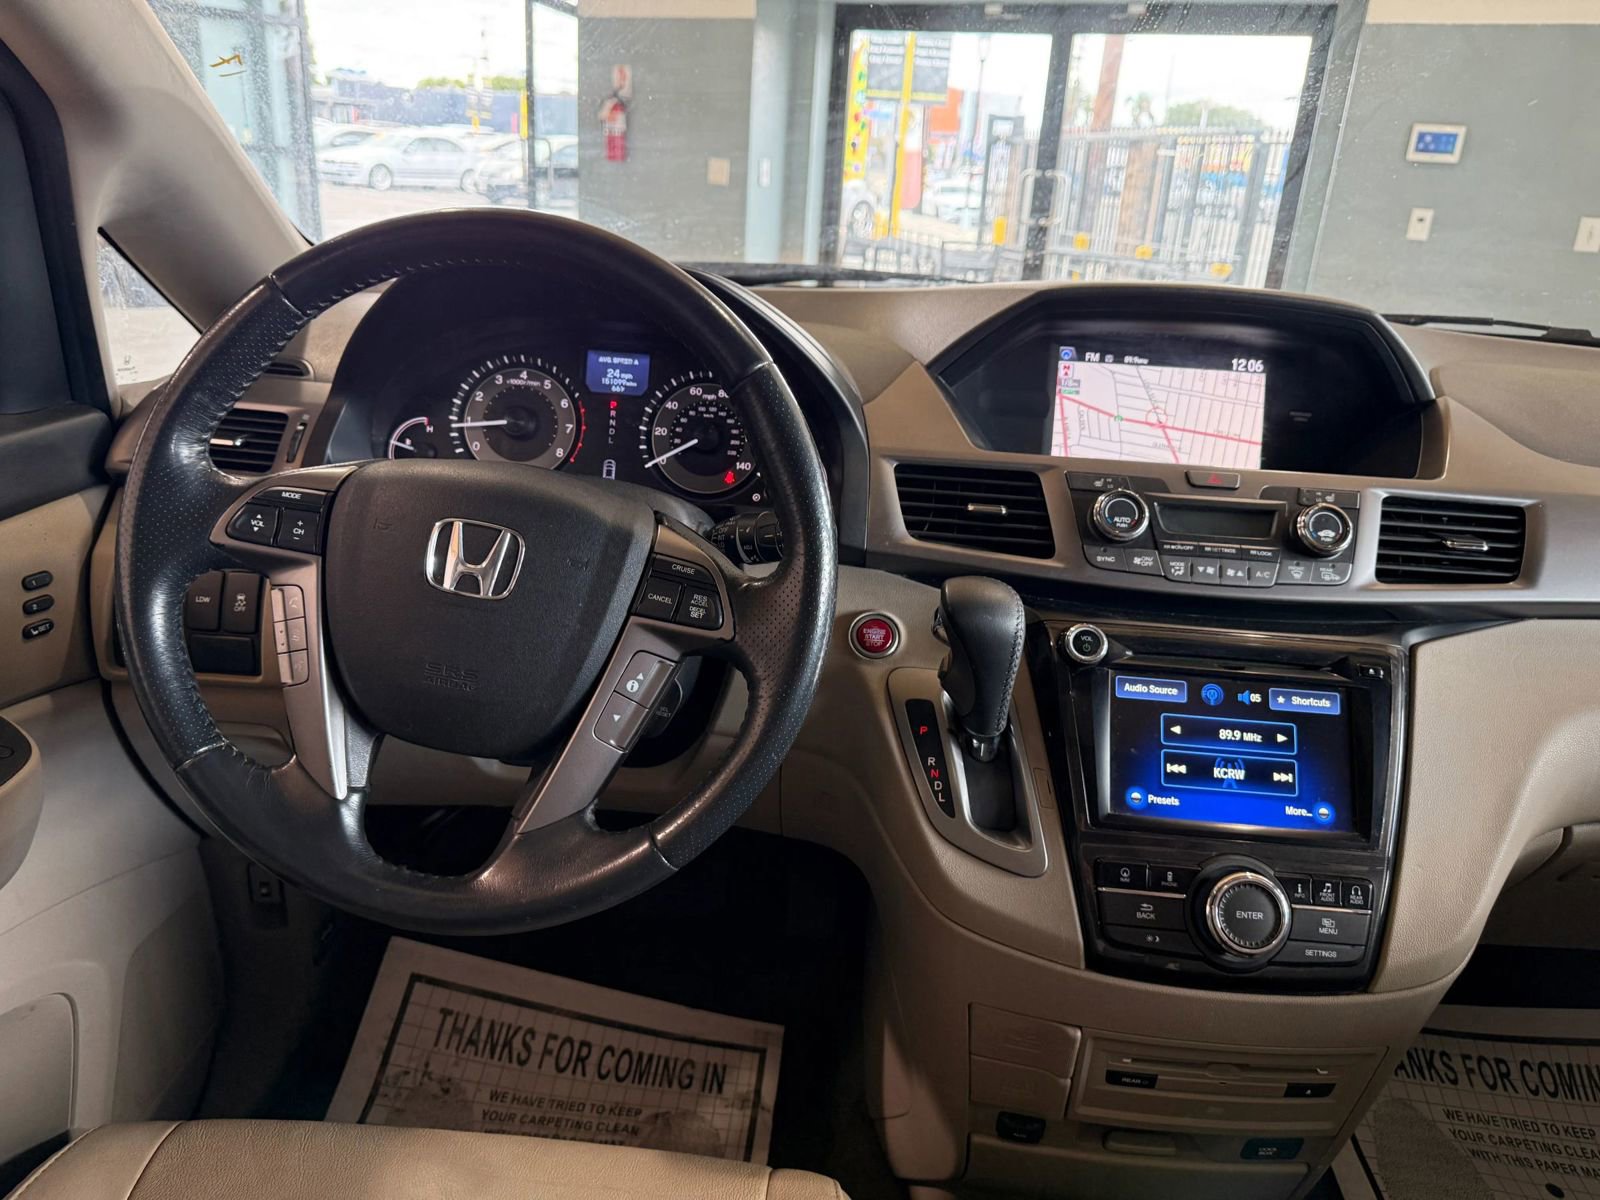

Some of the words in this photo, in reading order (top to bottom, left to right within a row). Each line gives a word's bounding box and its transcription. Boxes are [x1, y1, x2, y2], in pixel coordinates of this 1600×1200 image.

[1085, 352, 1100, 362] FM
[520, 370, 528, 380] 4
[607, 368, 620, 378] 24
[495, 375, 503, 385] 3
[543, 380, 552, 390] 5
[475, 391, 484, 402] 2
[689, 387, 703, 396] 60
[560, 399, 569, 408] 6
[665, 401, 678, 410] 40
[609, 419, 616, 427] N
[426, 425, 434, 433] H
[565, 424, 573, 434] 7
[654, 427, 668, 436] 20
[472, 442, 480, 451] 0
[556, 448, 564, 458] 8
[736, 462, 751, 470] 140
[281, 491, 302, 499] MODE
[251, 519, 264, 527] VOL
[293, 527, 304, 535] CH
[672, 563, 695, 575] CRUISE
[648, 593, 673, 605] CANCEL
[690, 611, 704, 619] SET
[1124, 682, 1148, 694] Audio
[1150, 685, 1178, 696] Source
[1250, 693, 1262, 703] 05
[1291, 696, 1331, 708] Shortcuts
[1218, 729, 1241, 741] 89.9
[1243, 733, 1262, 743] MHz
[928, 757, 936, 766] R
[931, 769, 939, 778] N
[1213, 767, 1245, 780] KCRW
[935, 781, 943, 790] D
[939, 793, 945, 802] L
[1148, 795, 1180, 807] Presets
[1136, 912, 1156, 920] BACK
[1236, 910, 1264, 920] ENTER
[1318, 927, 1338, 935] MENU
[1305, 949, 1337, 958] SETTINGS
[432, 1007, 536, 1067] THANKS
[537, 1035, 591, 1077] FOR
[598, 1044, 696, 1091] COMING
[702, 1063, 727, 1095] IN
[1460, 1054, 1519, 1094] FOR
[489, 1089, 509, 1103] WE
[510, 1093, 545, 1108] HAVE
[548, 1098, 586, 1112] TRIED
[590, 1104, 606, 1115] TO
[608, 1104, 643, 1118] KEEP
[481, 1109, 516, 1123] YOUR
[519, 1113, 593, 1131] CARPETING
[596, 1122, 640, 1136] CLEAN
[1441, 1108, 1464, 1122] WE
[1467, 1113, 1500, 1128] HAVE
[1503, 1117, 1540, 1132] TRIED
[1541, 1122, 1560, 1136] TO
[1562, 1126, 1596, 1140] KEEP
[1448, 1127, 1486, 1143] YOUR
[1488, 1134, 1563, 1155] CARPETING
[1467, 1147, 1500, 1163] WITH
[1503, 1154, 1535, 1169] THIS
[1535, 1159, 1578, 1176] PAPER
